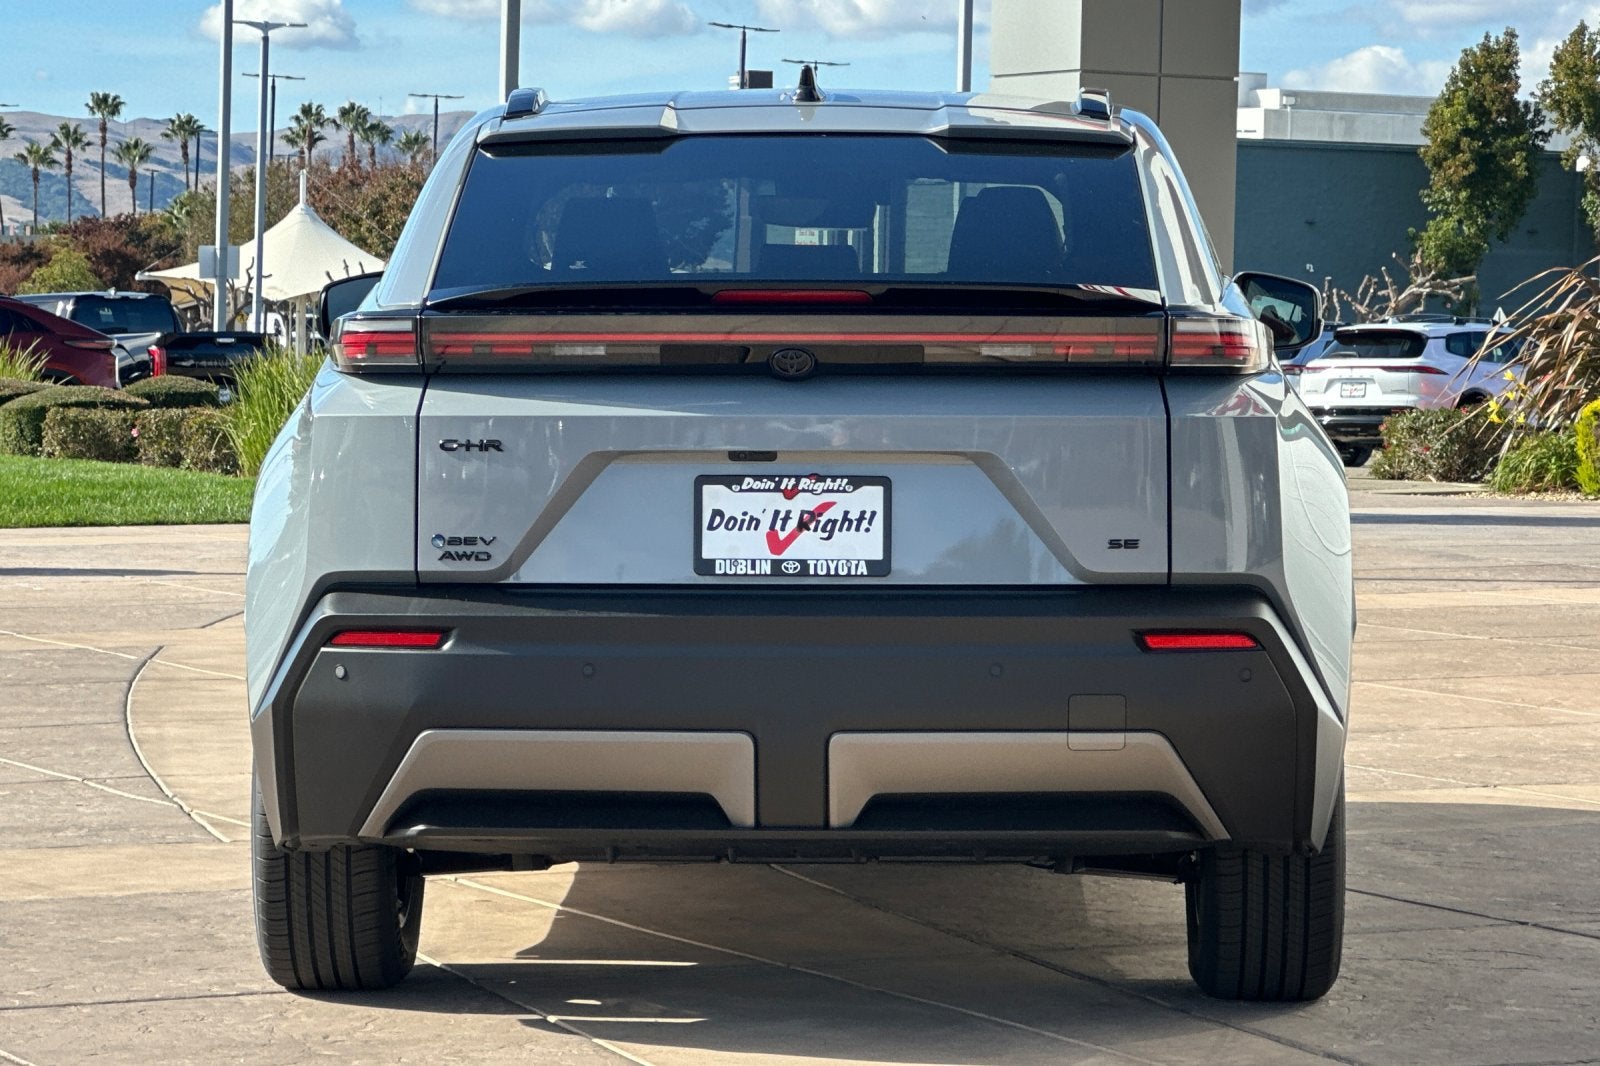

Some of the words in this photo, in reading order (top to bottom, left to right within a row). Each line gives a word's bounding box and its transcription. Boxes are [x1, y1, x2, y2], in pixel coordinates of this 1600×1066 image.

[440, 439, 503, 452] C-HR
[742, 477, 779, 490] Doin'
[780, 478, 796, 490] It
[798, 478, 848, 494] Right!
[706, 508, 766, 532] Doin'
[769, 509, 792, 532] It
[796, 510, 877, 541] Right!
[447, 536, 496, 546] BEV
[1107, 539, 1140, 549] SE
[438, 551, 492, 562] AWD
[715, 560, 771, 575] DUBLIN
[807, 561, 868, 576] TOYOTA
